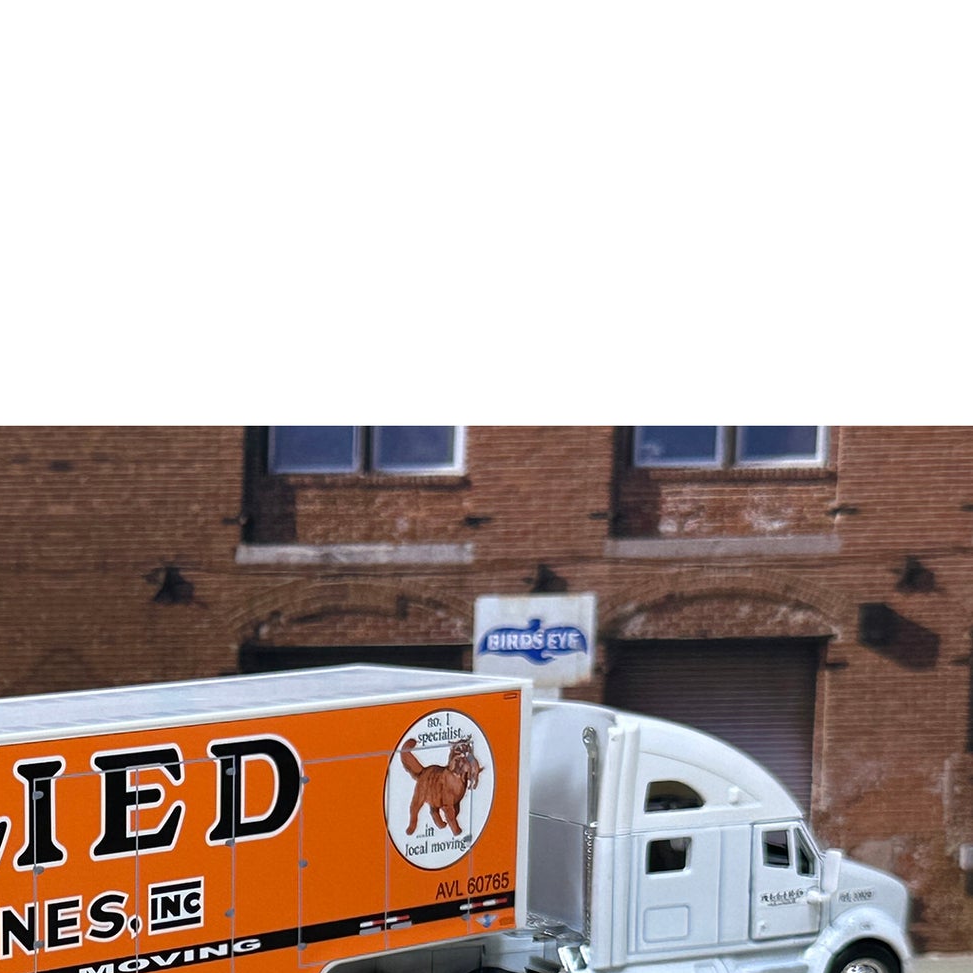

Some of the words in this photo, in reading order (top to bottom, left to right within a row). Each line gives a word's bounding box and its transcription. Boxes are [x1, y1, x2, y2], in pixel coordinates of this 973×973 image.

[547, 632, 581, 650] EYE
[405, 840, 428, 857] local
[435, 879, 463, 901] AVL
[467, 871, 509, 895] 60765
[149, 887, 203, 924] INC
